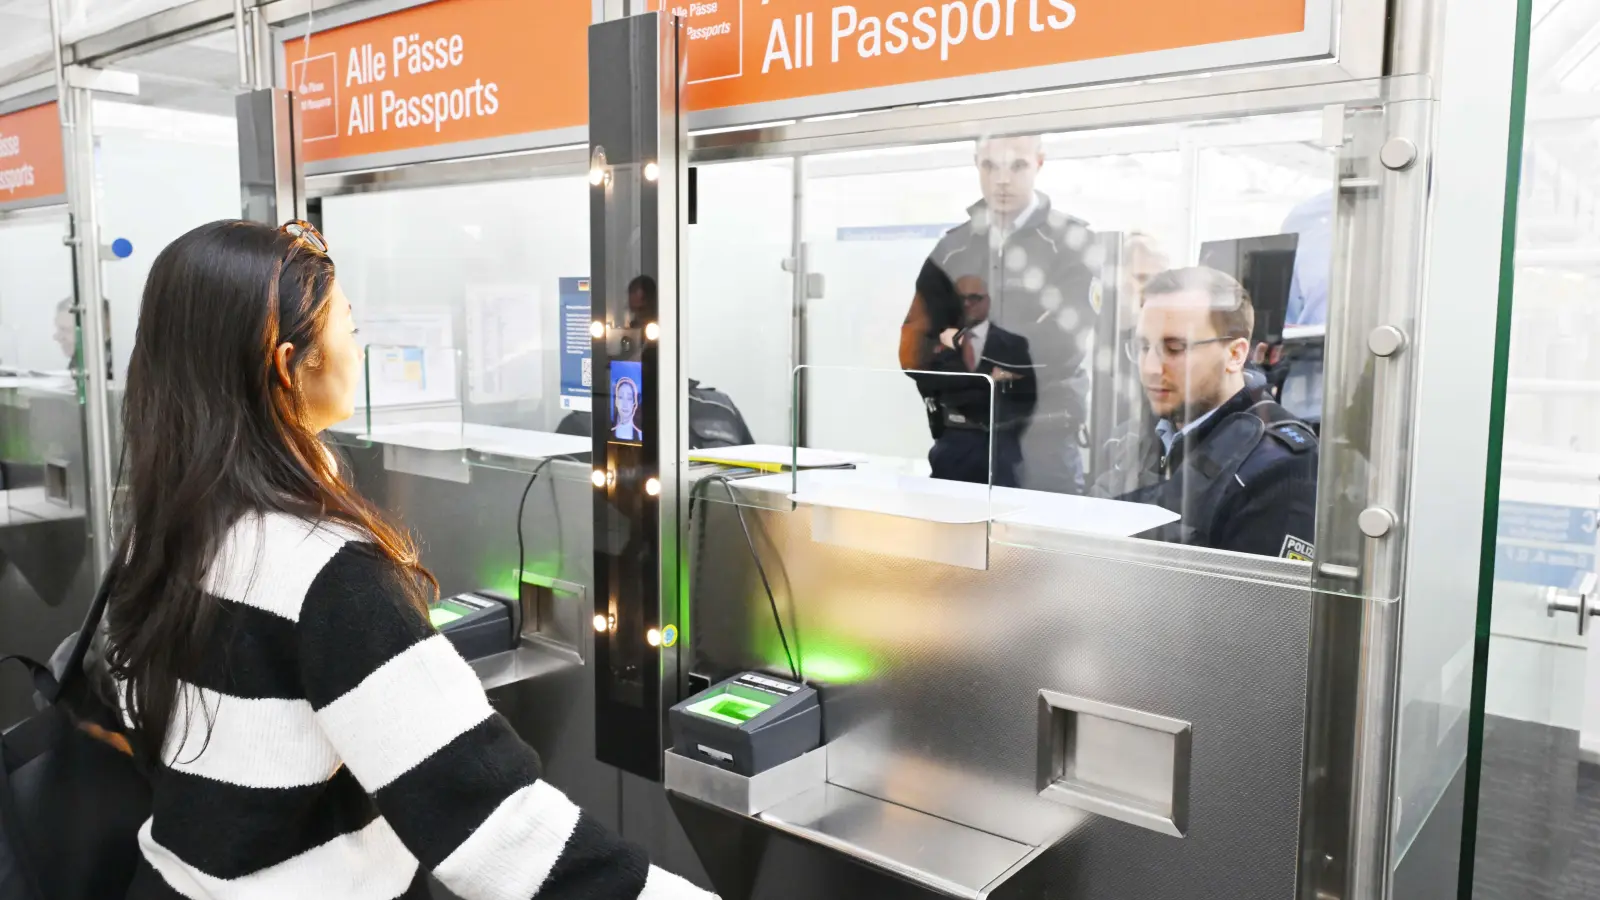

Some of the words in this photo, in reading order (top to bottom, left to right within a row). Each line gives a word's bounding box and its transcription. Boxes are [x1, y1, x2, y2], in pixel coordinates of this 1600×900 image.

[346, 43, 386, 87] Alle
[393, 33, 463, 77] Pässe
[761, 12, 813, 74] All
[831, 0, 1076, 62] Passports
[347, 93, 375, 136] All
[381, 78, 499, 133] Passports
[1287, 539, 1315, 560] POLIZ
